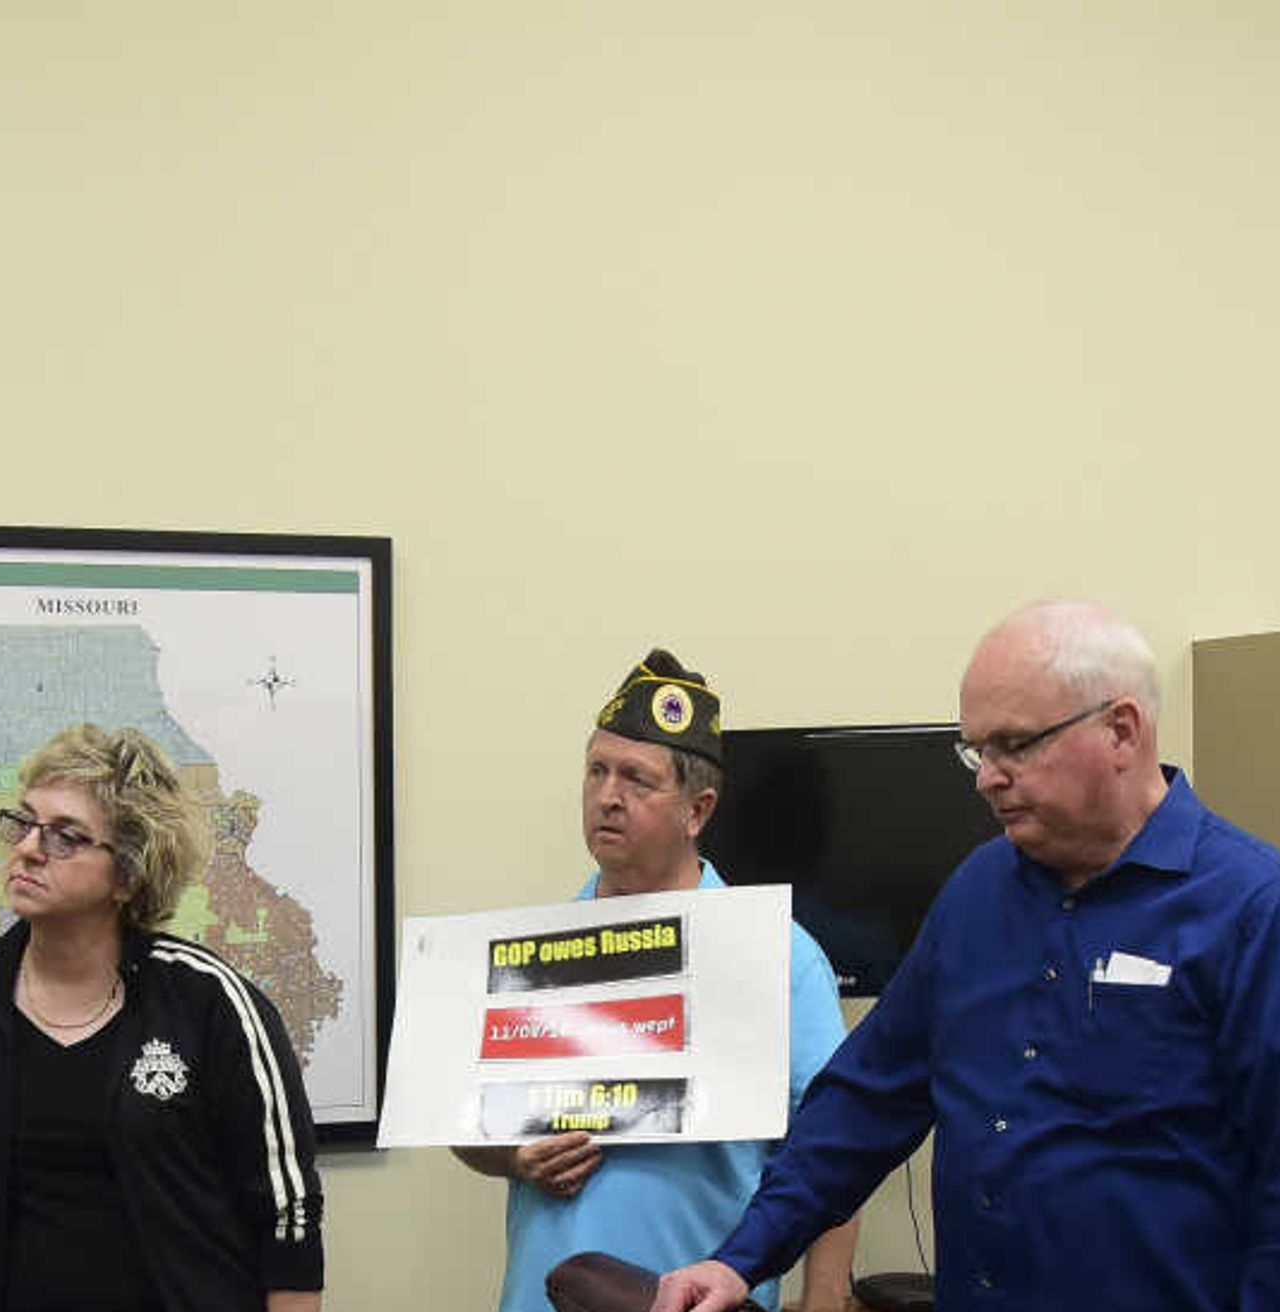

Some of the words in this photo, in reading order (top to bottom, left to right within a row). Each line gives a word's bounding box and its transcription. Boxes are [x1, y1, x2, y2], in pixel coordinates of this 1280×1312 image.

[35, 598, 139, 615] MISSOURI
[494, 941, 535, 966] GOP
[539, 935, 596, 961] owes
[601, 924, 676, 954] Russia
[589, 1083, 639, 1108] 6:10
[552, 1111, 610, 1130] Trump
